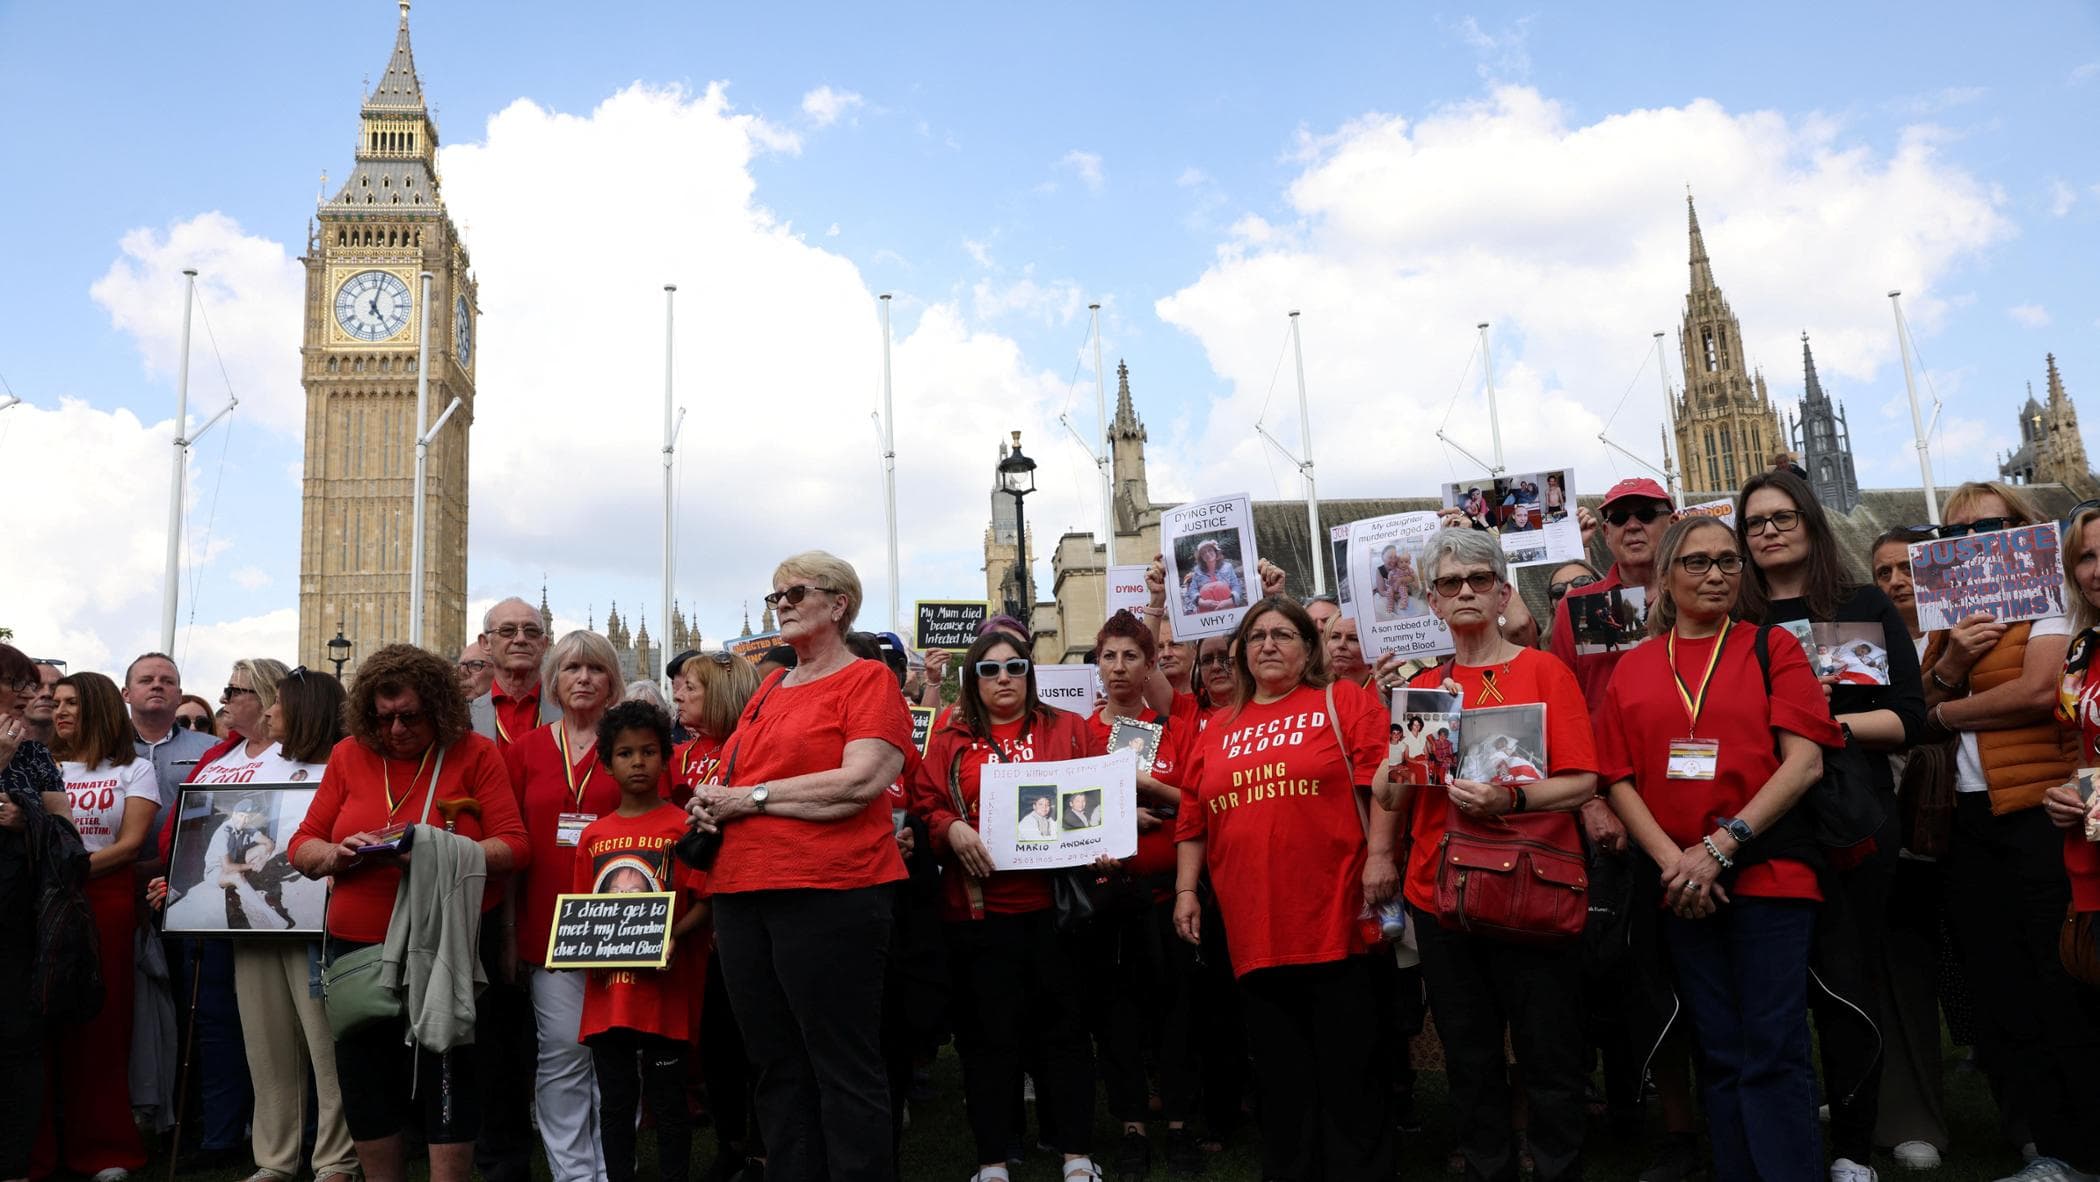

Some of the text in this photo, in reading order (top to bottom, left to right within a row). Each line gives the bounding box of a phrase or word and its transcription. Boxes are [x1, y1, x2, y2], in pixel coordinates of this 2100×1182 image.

[1174, 502, 1234, 523] DYING FOR
[1182, 516, 1227, 533] JUSTICE
[1371, 515, 1424, 531] My daughter
[1358, 522, 1436, 543] murdered aged 28
[1914, 526, 2057, 569] JUSTICE
[1942, 559, 2031, 583] FOR ALL
[1115, 584, 1144, 593] DYING
[1916, 572, 2065, 605] INFECTED BLOOD
[920, 606, 983, 623] My Mum died
[1200, 613, 1235, 627] WHY ?
[929, 620, 977, 632] because of
[1371, 626, 1378, 634] A
[1378, 625, 1393, 633] son
[1393, 620, 1422, 631] robbed
[1422, 619, 1431, 627] of
[925, 633, 961, 645] Infected
[1383, 632, 1426, 643] mummy by
[1380, 640, 1436, 654] Infected Blood
[1039, 687, 1084, 698] JUSTICE
[1222, 712, 1325, 750] INFECTED
[1227, 731, 1304, 759] BLOOD
[993, 768, 1021, 779] DIED
[1232, 762, 1287, 787] DYING
[1209, 779, 1320, 815] FOR JUSTICE
[1015, 837, 1102, 852] MARIO ANDREOU
[562, 901, 667, 923] I didnt get to
[558, 921, 591, 937] meet
[593, 922, 616, 942] my
[553, 940, 663, 957] due to Infected Blood
